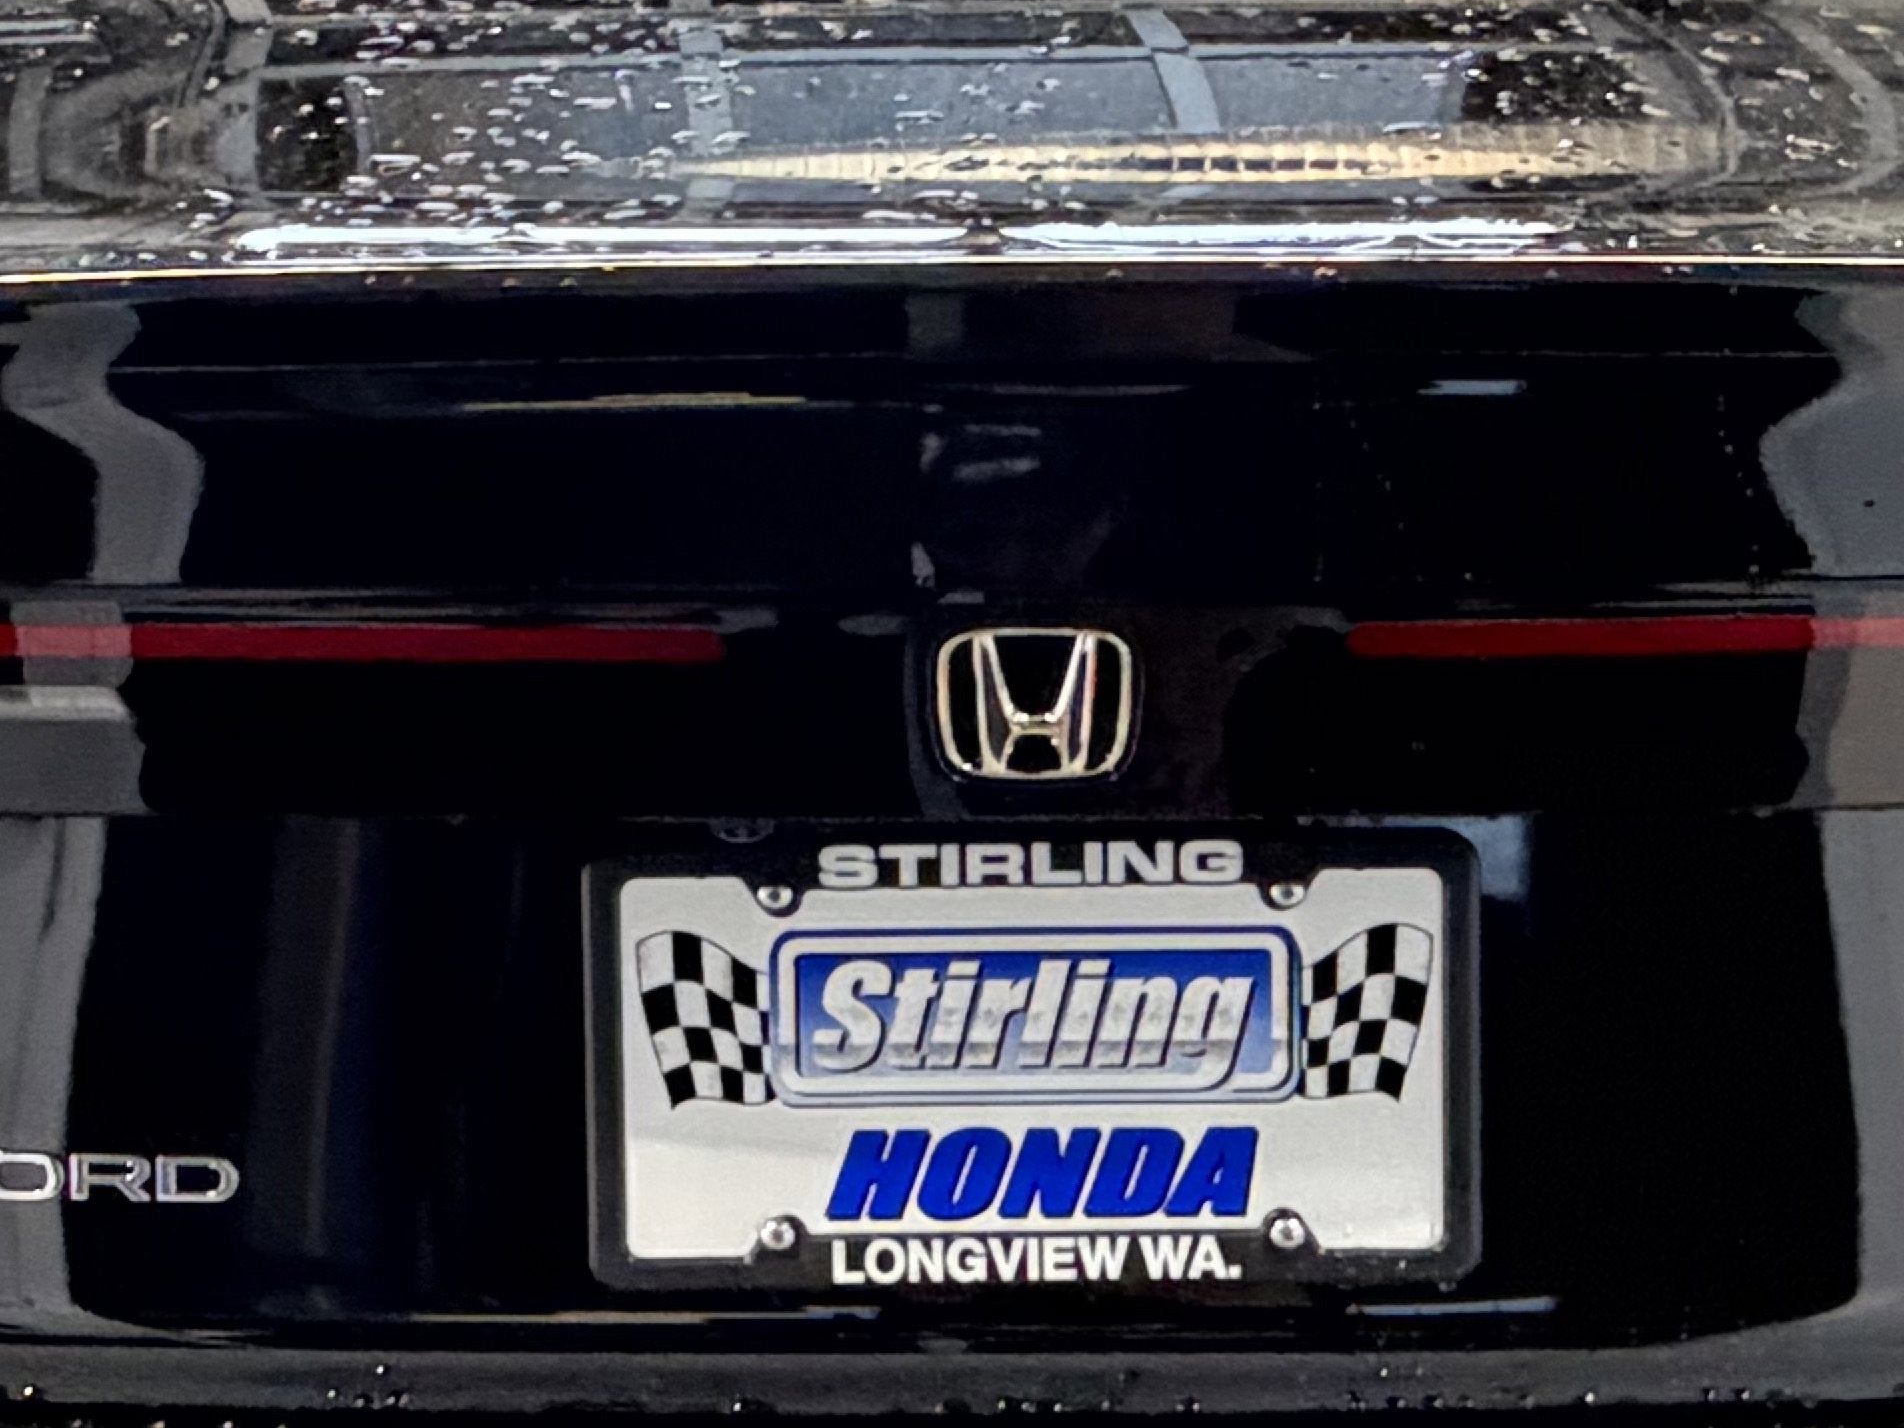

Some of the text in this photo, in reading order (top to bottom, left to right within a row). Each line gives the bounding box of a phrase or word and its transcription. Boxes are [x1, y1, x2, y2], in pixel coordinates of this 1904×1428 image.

[818, 838, 1243, 887] STIRLING
[812, 958, 1256, 1093] Stirling
[825, 1126, 1260, 1222] HONDA
[831, 1236, 1129, 1284] LONGVIEW
